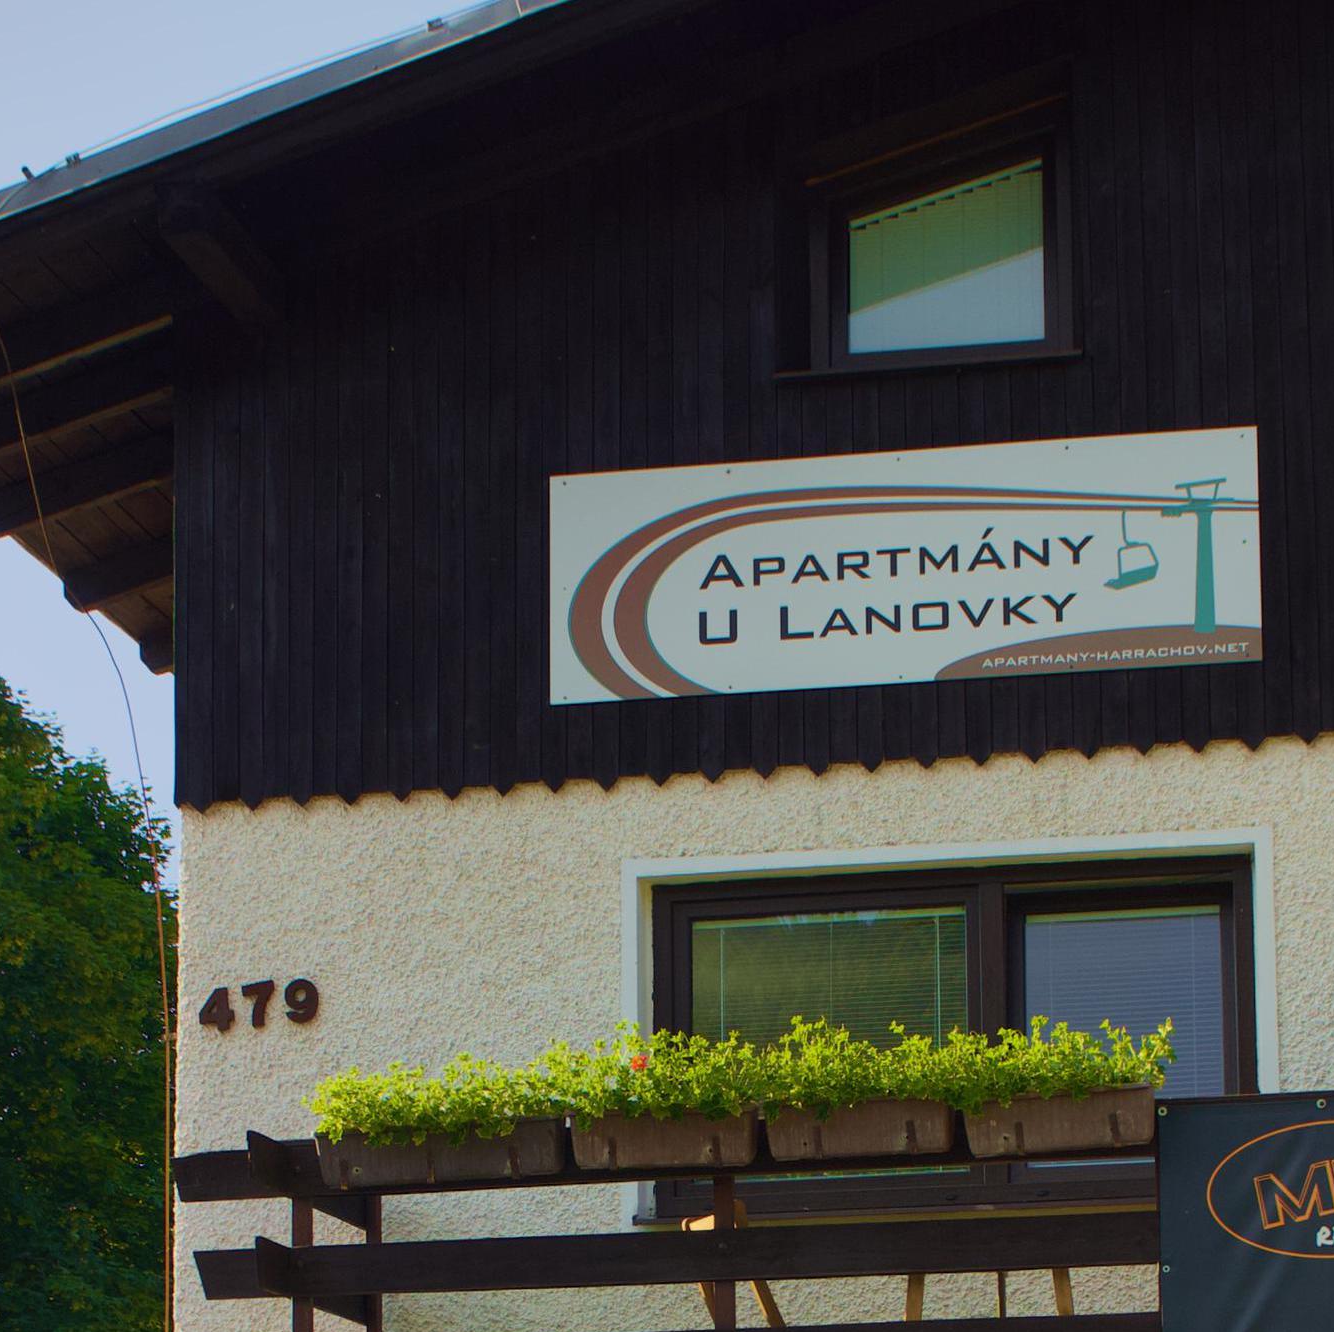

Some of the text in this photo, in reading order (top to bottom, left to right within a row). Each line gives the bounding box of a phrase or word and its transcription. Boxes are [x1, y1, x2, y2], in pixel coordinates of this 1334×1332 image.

[698, 525, 1094, 590] APARTMÁNY
[698, 592, 1078, 645] U LANOVKY
[981, 641, 1249, 669] APARTMANY-HARRACHOV.NET
[199, 977, 319, 1031] 479
